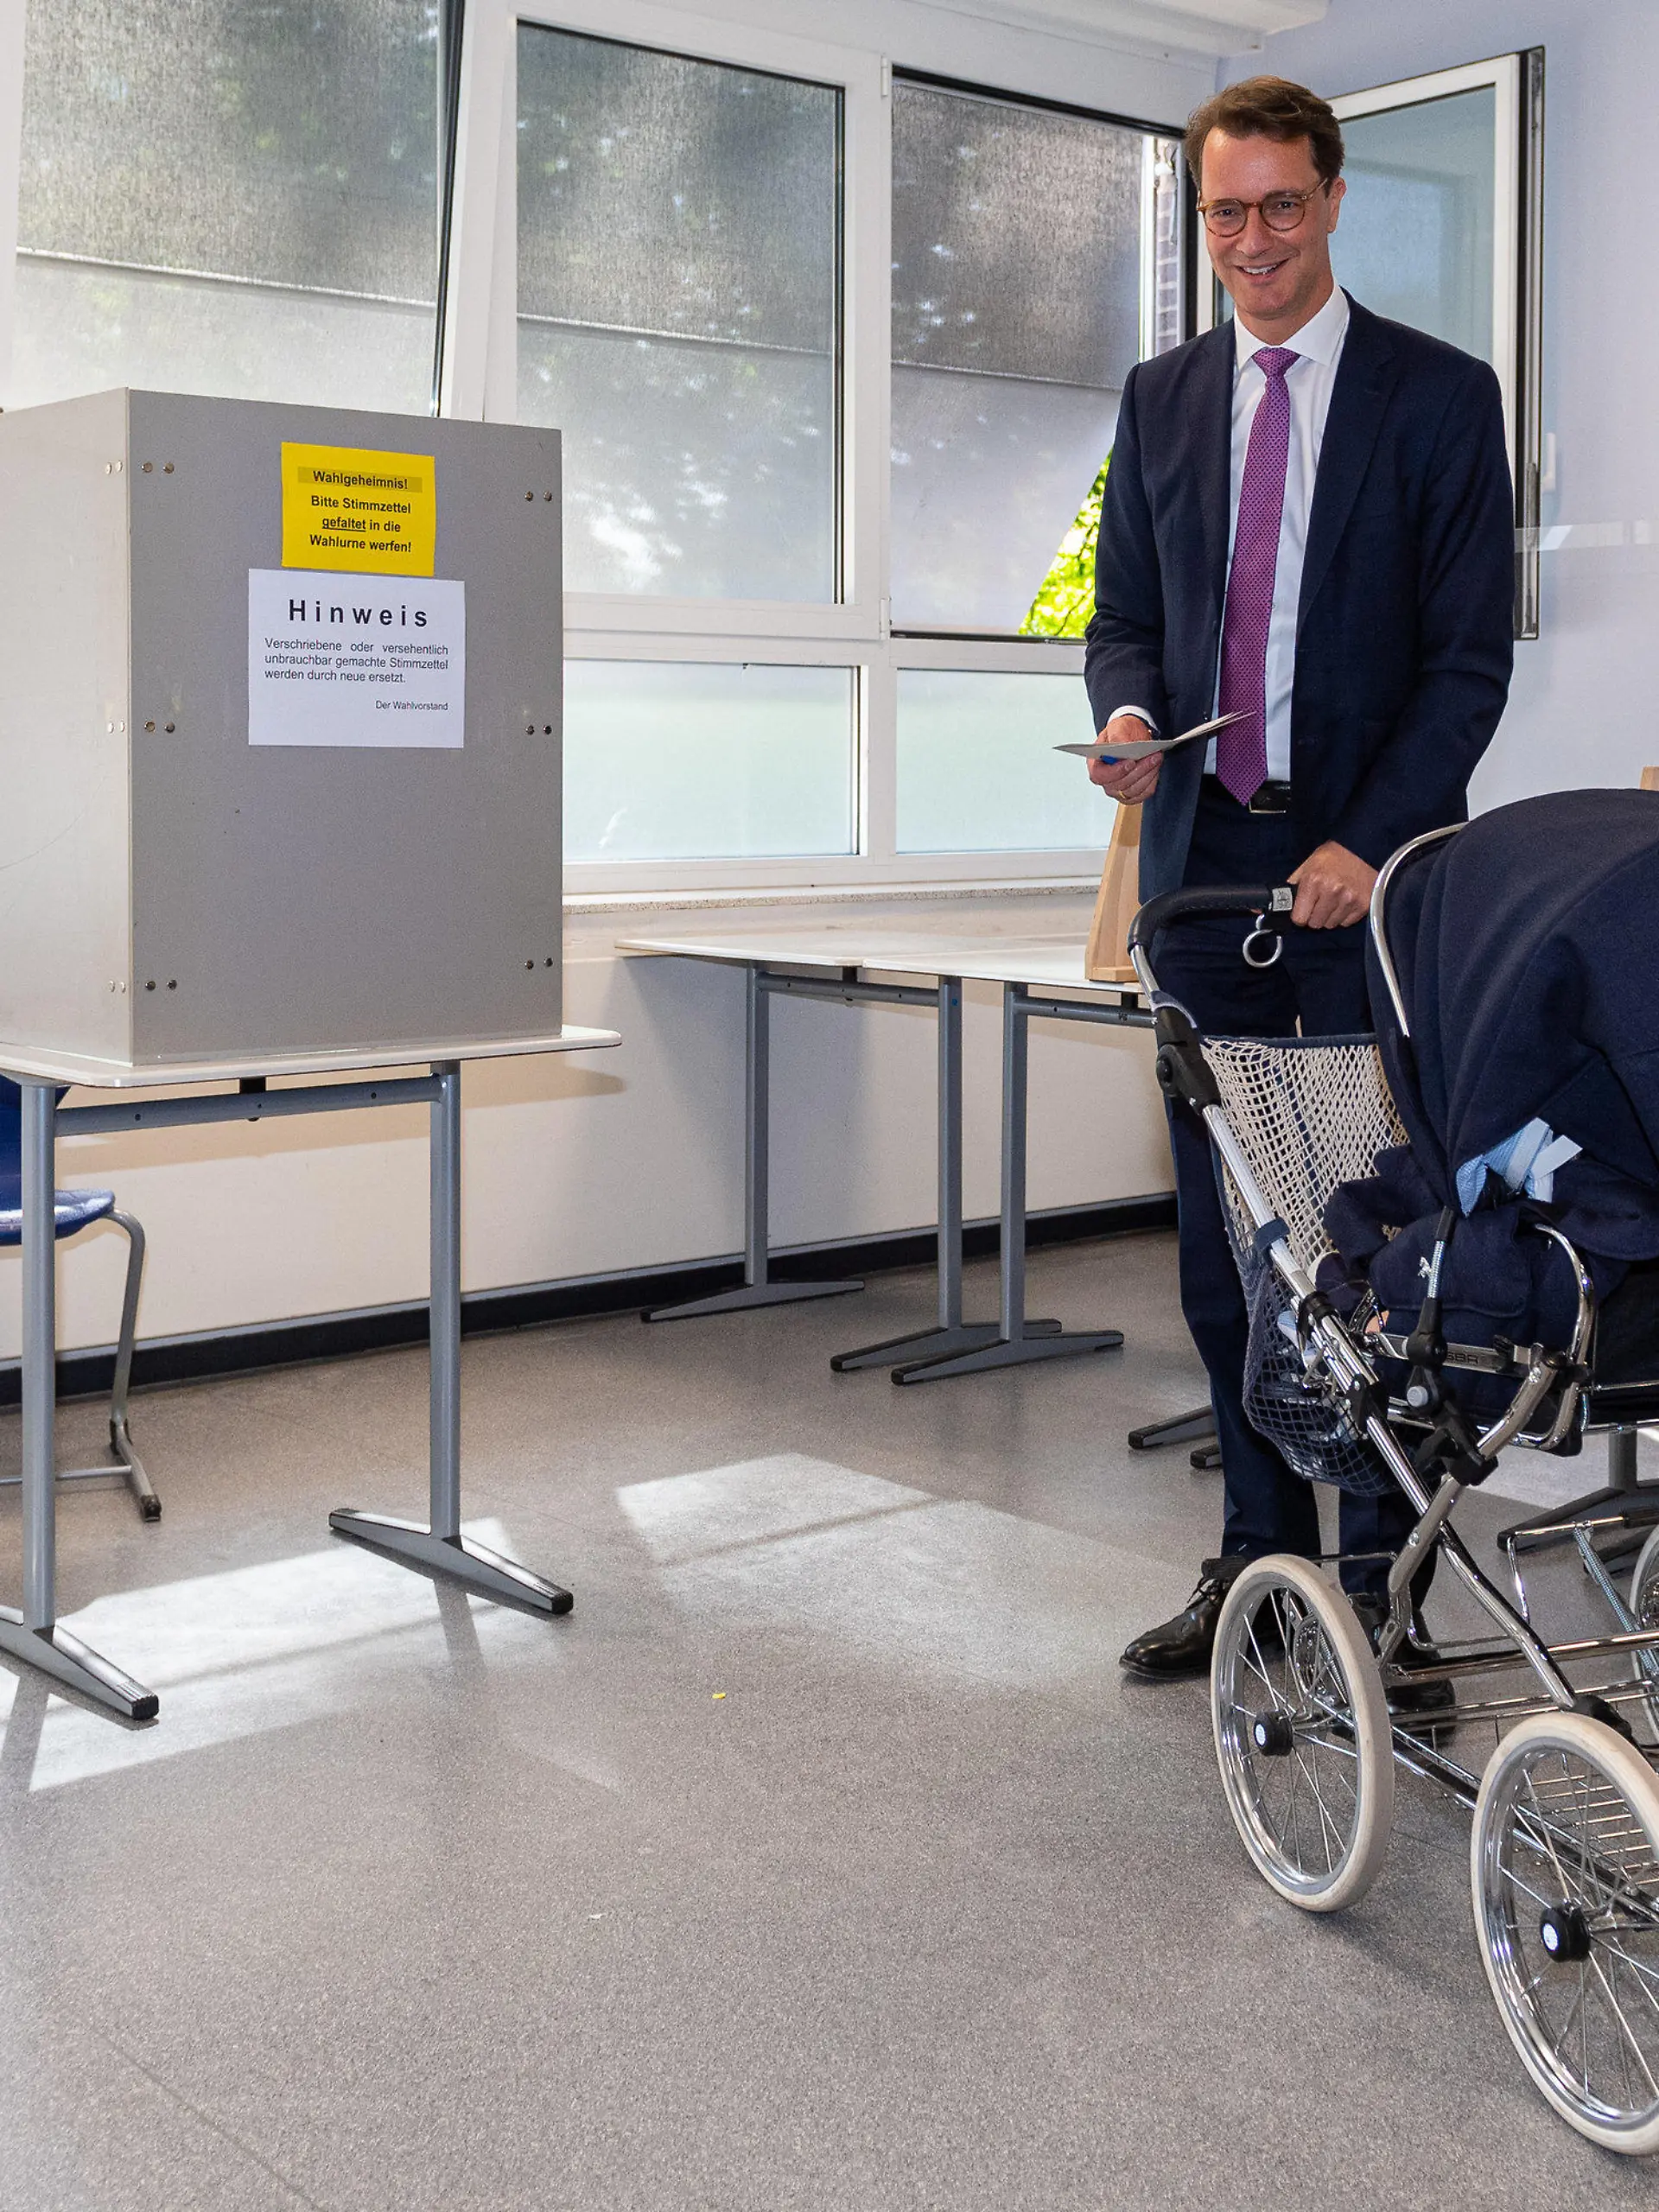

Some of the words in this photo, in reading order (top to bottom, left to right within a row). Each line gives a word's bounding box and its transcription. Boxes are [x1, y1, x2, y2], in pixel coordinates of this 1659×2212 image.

[313, 470, 408, 490] Wahlgeheimnis!
[311, 495, 340, 508] Bitte
[342, 497, 411, 513] Stimmzettel
[322, 517, 366, 531] gefaltet
[369, 519, 380, 531] in
[383, 520, 401, 532] die
[309, 534, 365, 549] Wahlurne
[369, 539, 411, 553] werfen!
[289, 599, 428, 627] Hinweis
[264, 638, 342, 652] Verschriebene
[350, 640, 374, 652] oder
[382, 642, 448, 655] versehentlich
[264, 653, 333, 666] unbrauchbar
[335, 656, 386, 669] gemachte
[390, 658, 448, 670] Stimmzettel
[264, 668, 304, 680] werden
[307, 669, 337, 681] durch
[340, 672, 365, 682] neue
[368, 671, 406, 683] ersetzt.
[375, 700, 391, 709] Der
[393, 700, 448, 711] Wahlvorstand
